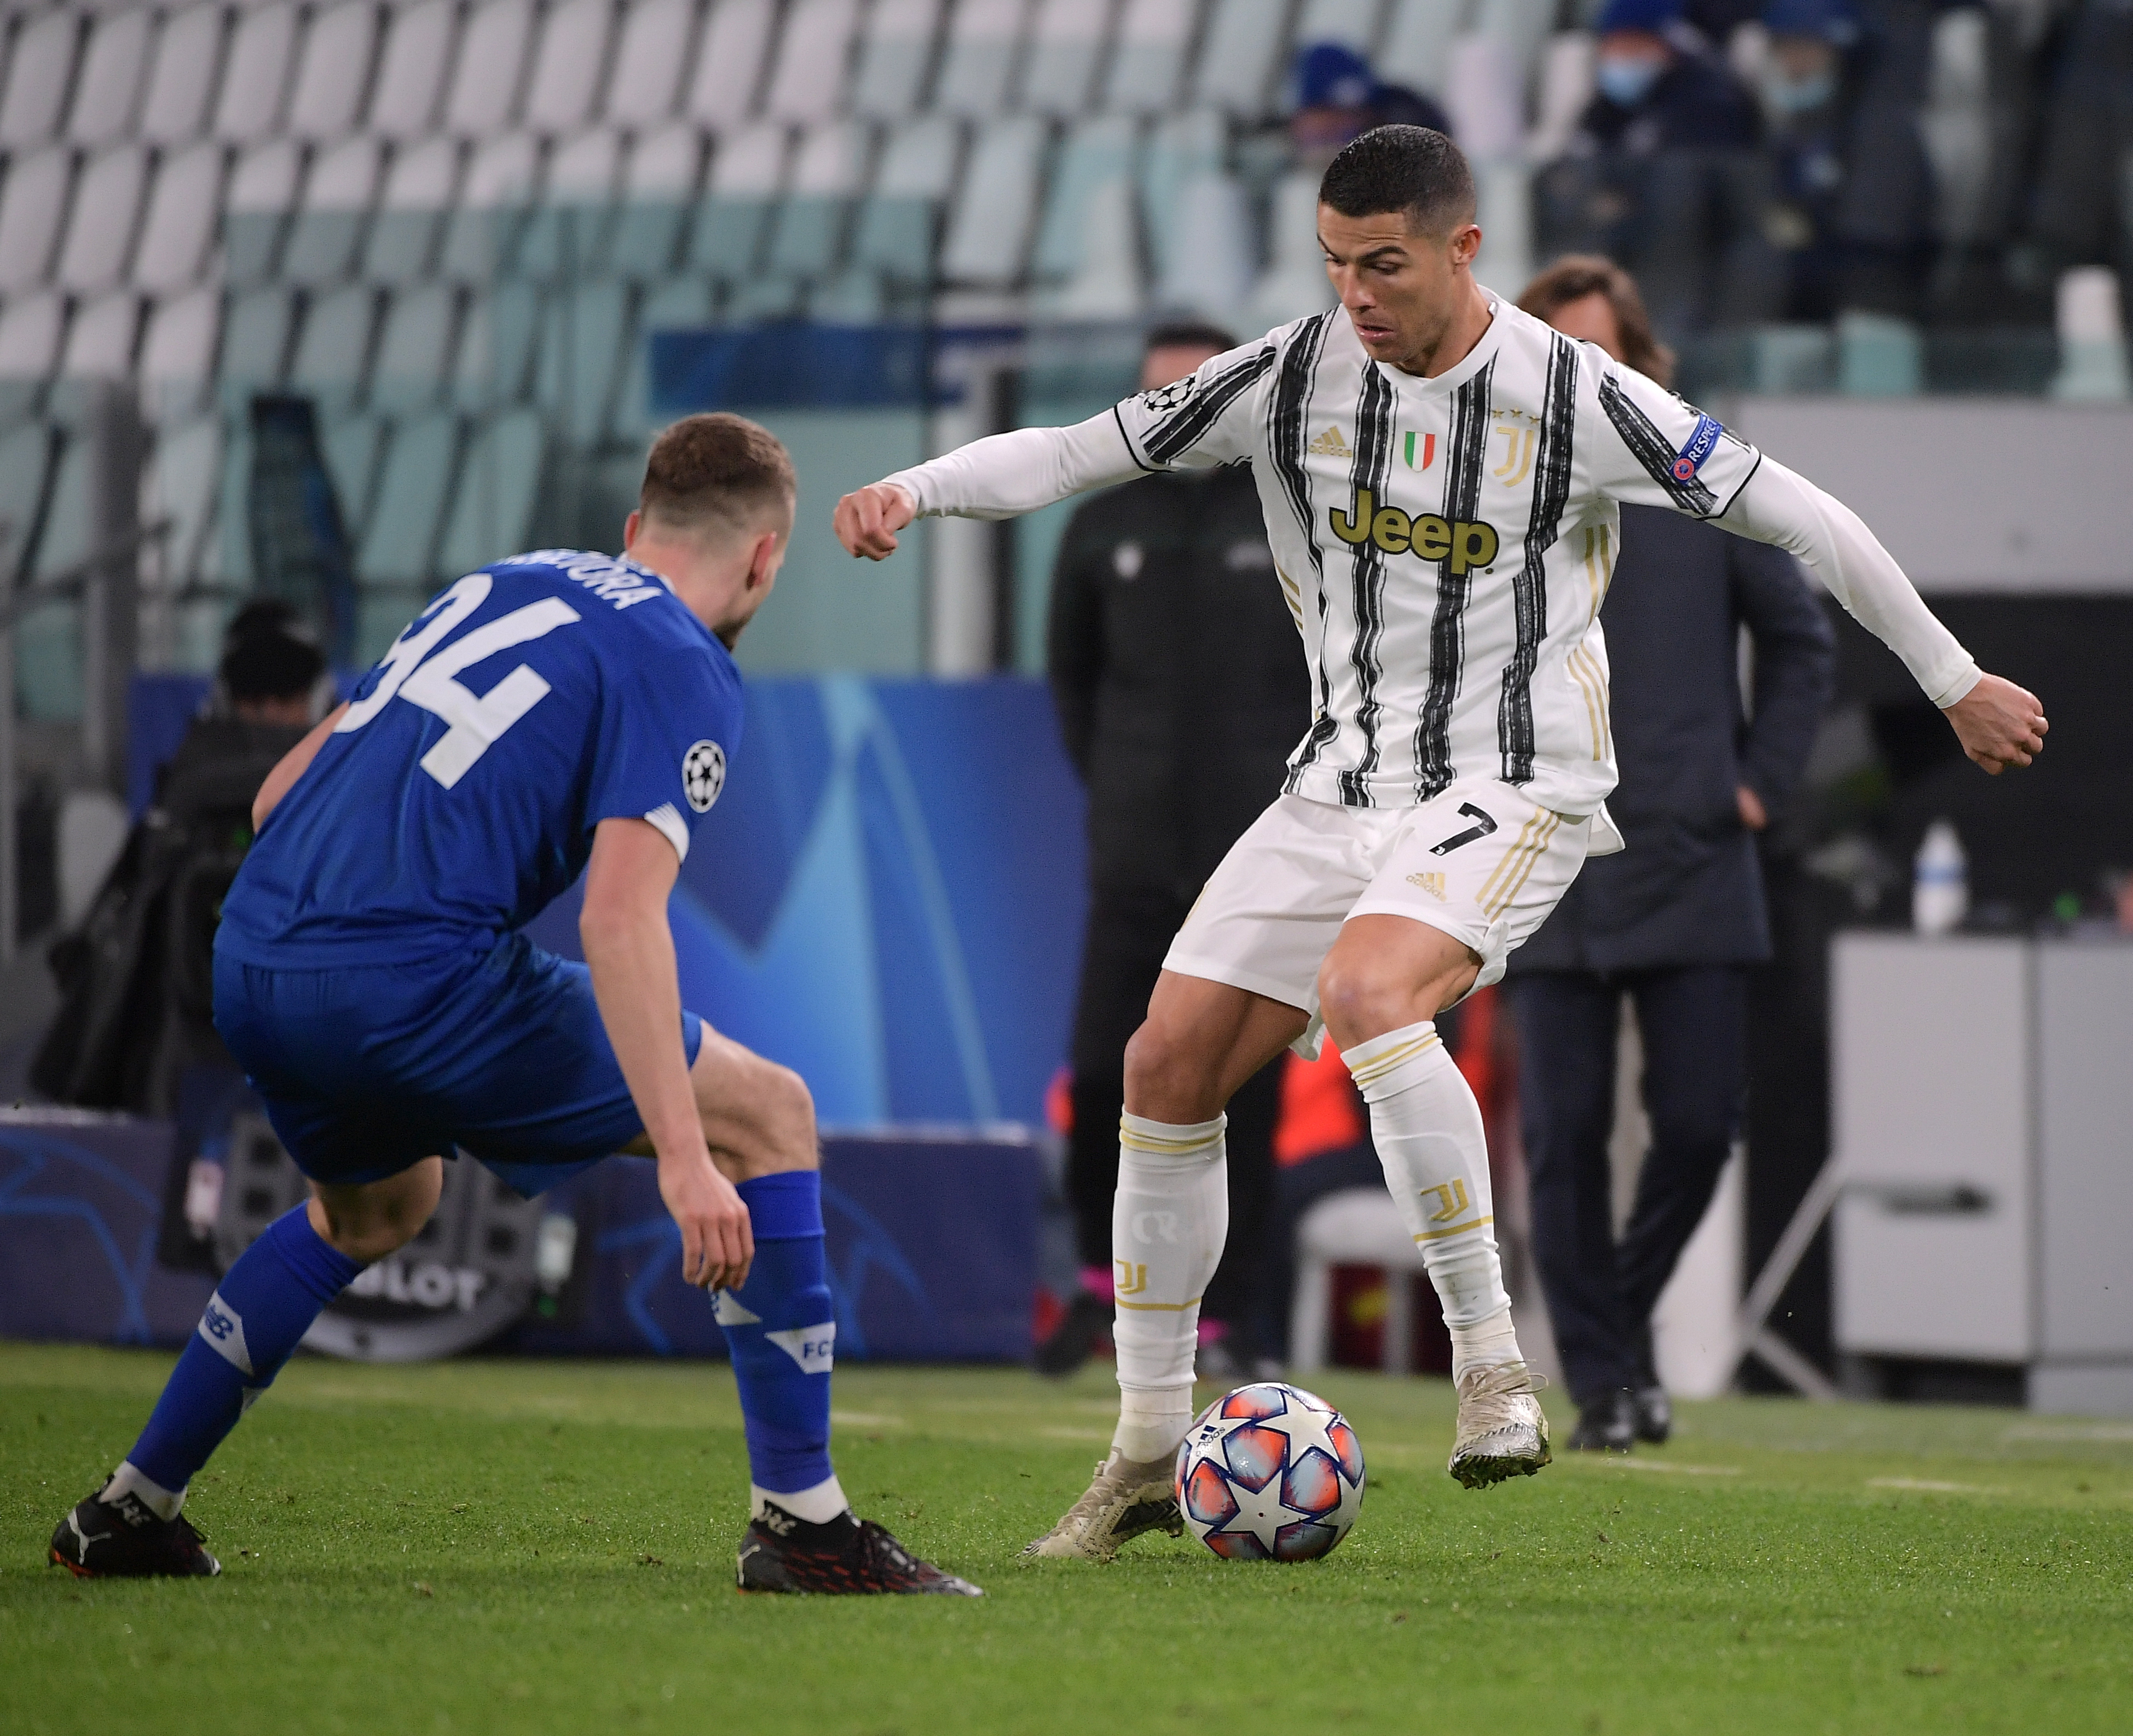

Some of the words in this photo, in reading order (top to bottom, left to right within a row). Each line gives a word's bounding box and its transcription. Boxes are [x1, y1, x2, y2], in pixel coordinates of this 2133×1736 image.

[1308, 444, 1352, 458] adidas
[1688, 416, 1717, 462] RESPECT
[1329, 490, 1499, 575] Jeep
[333, 573, 582, 790] 94
[1428, 801, 1498, 857] 7
[1406, 875, 1447, 901] adidas
